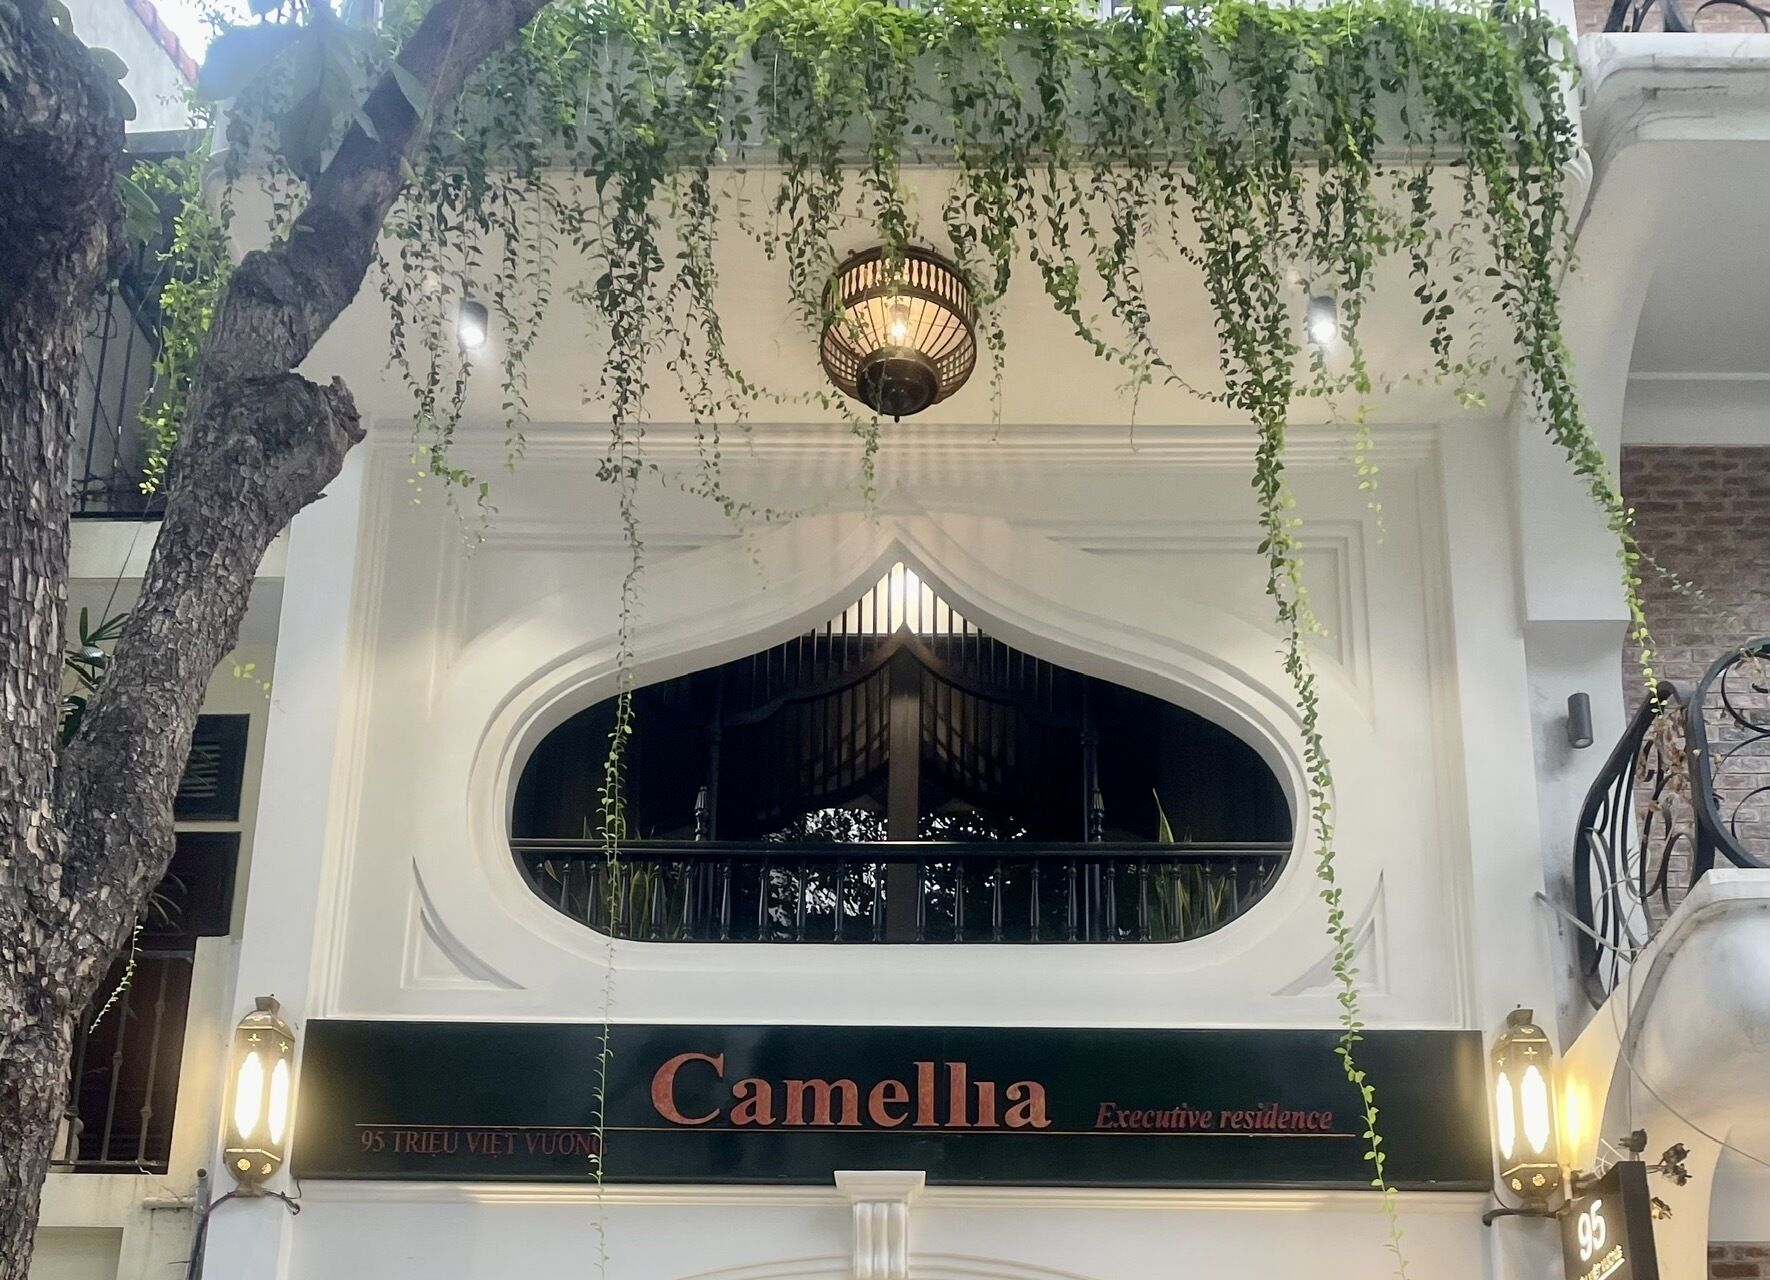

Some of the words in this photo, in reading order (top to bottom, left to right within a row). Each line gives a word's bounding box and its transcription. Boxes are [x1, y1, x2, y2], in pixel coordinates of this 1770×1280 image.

[1095, 1102, 1212, 1129] Executive
[1220, 1102, 1333, 1130] residence
[361, 1130, 385, 1152] 95
[1577, 1199, 1606, 1262] 95
